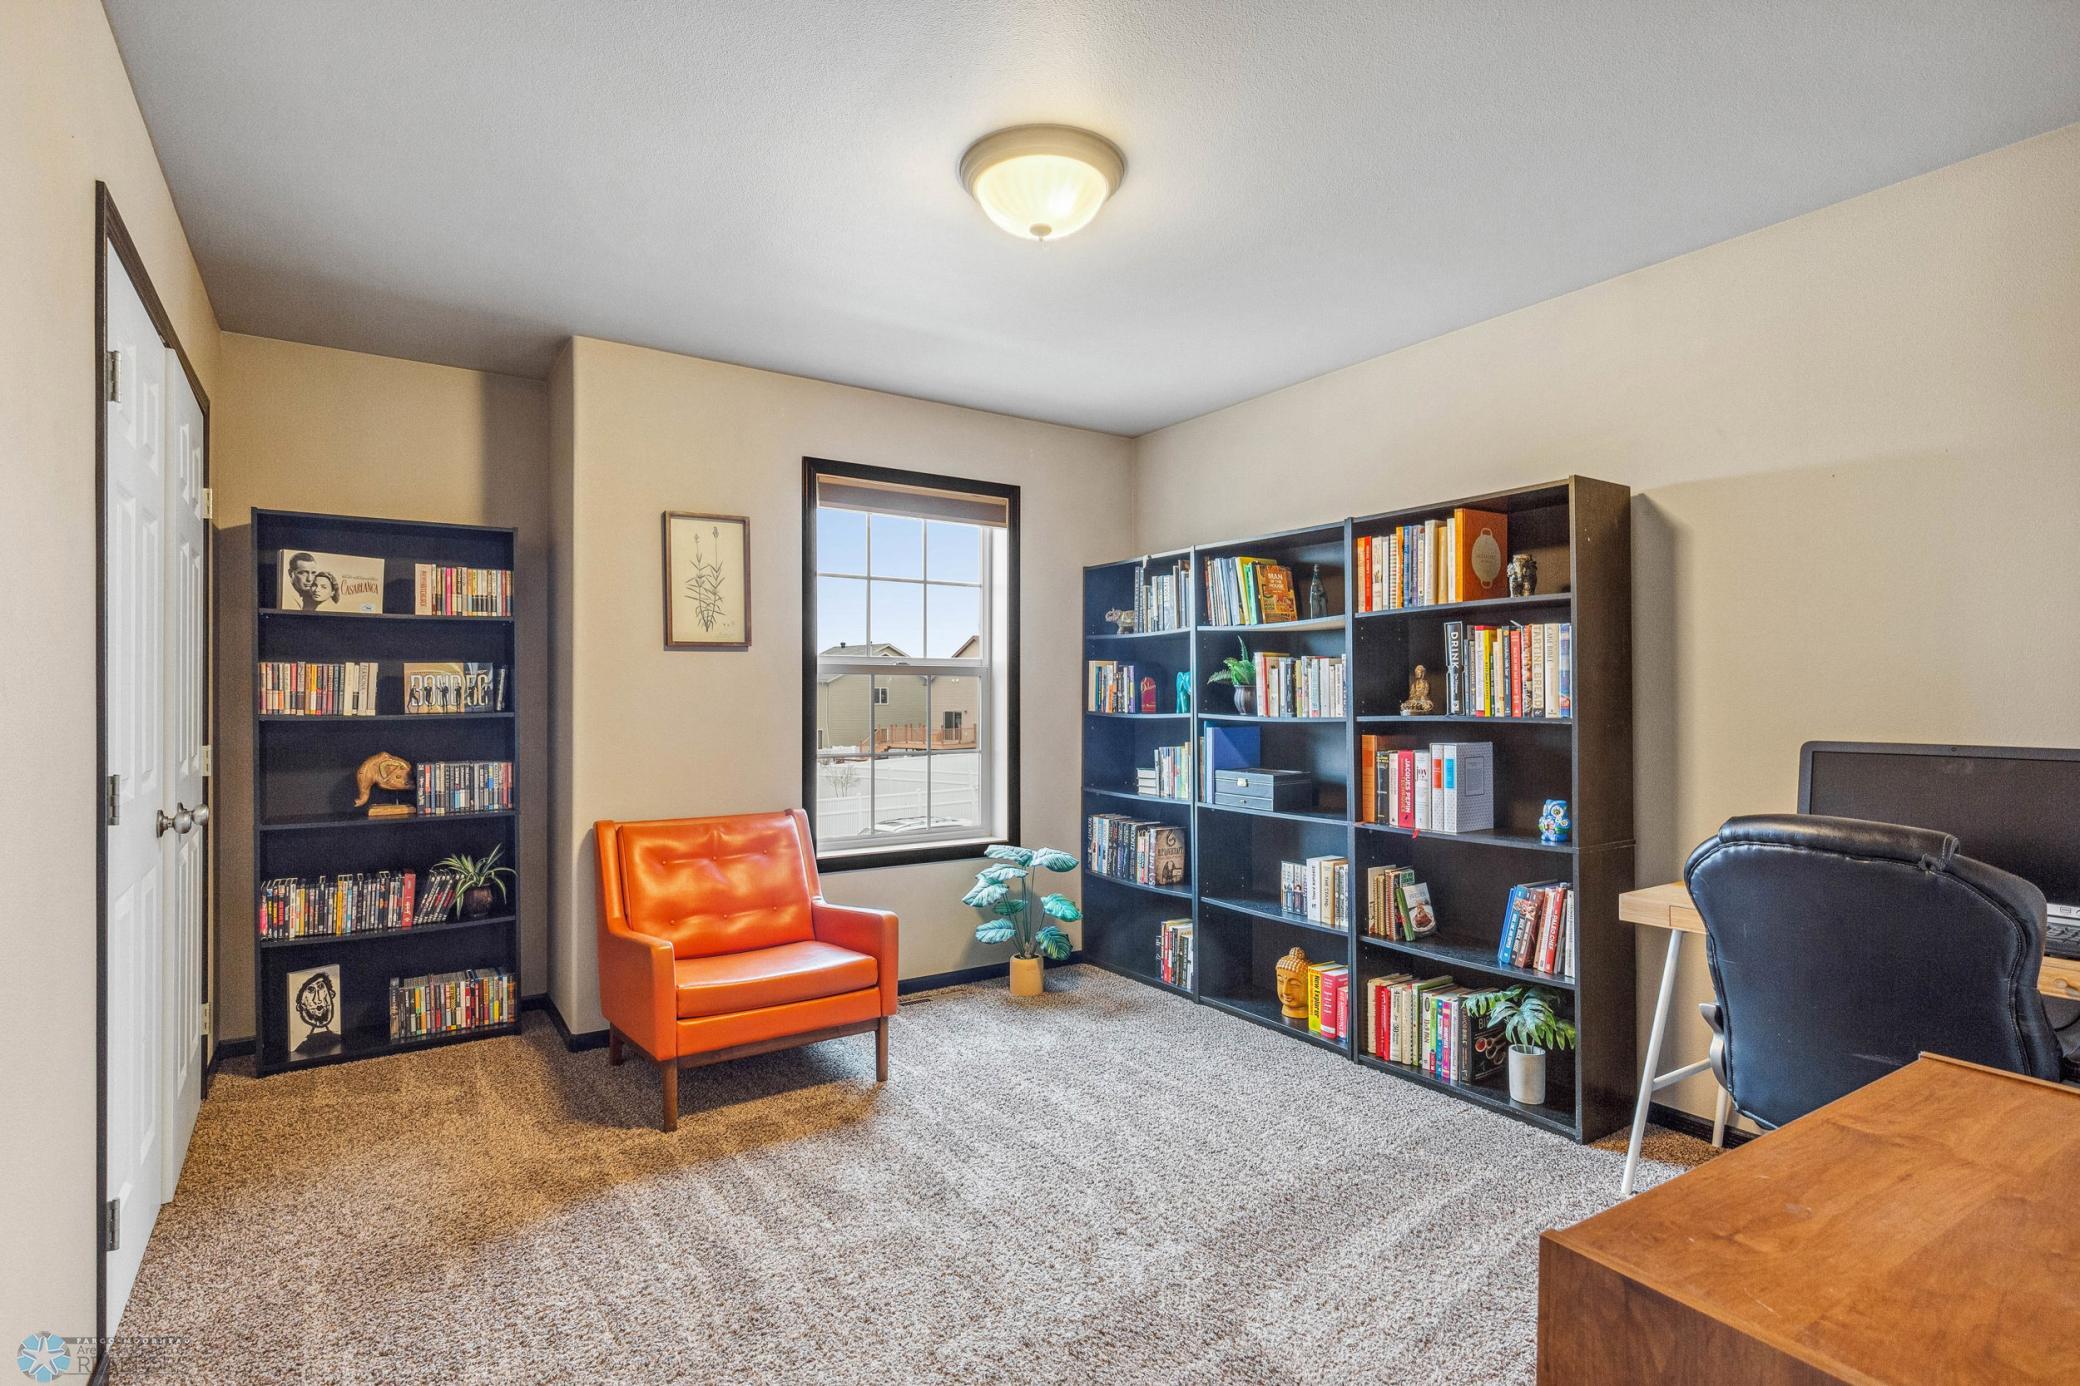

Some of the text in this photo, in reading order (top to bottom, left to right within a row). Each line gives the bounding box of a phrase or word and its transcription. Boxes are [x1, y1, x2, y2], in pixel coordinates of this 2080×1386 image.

[341, 579, 379, 595] CASABLANCA
[1450, 631, 1459, 669] DRINK
[1534, 626, 1542, 707] TARTINE BREAD
[410, 675, 462, 706] BOND
